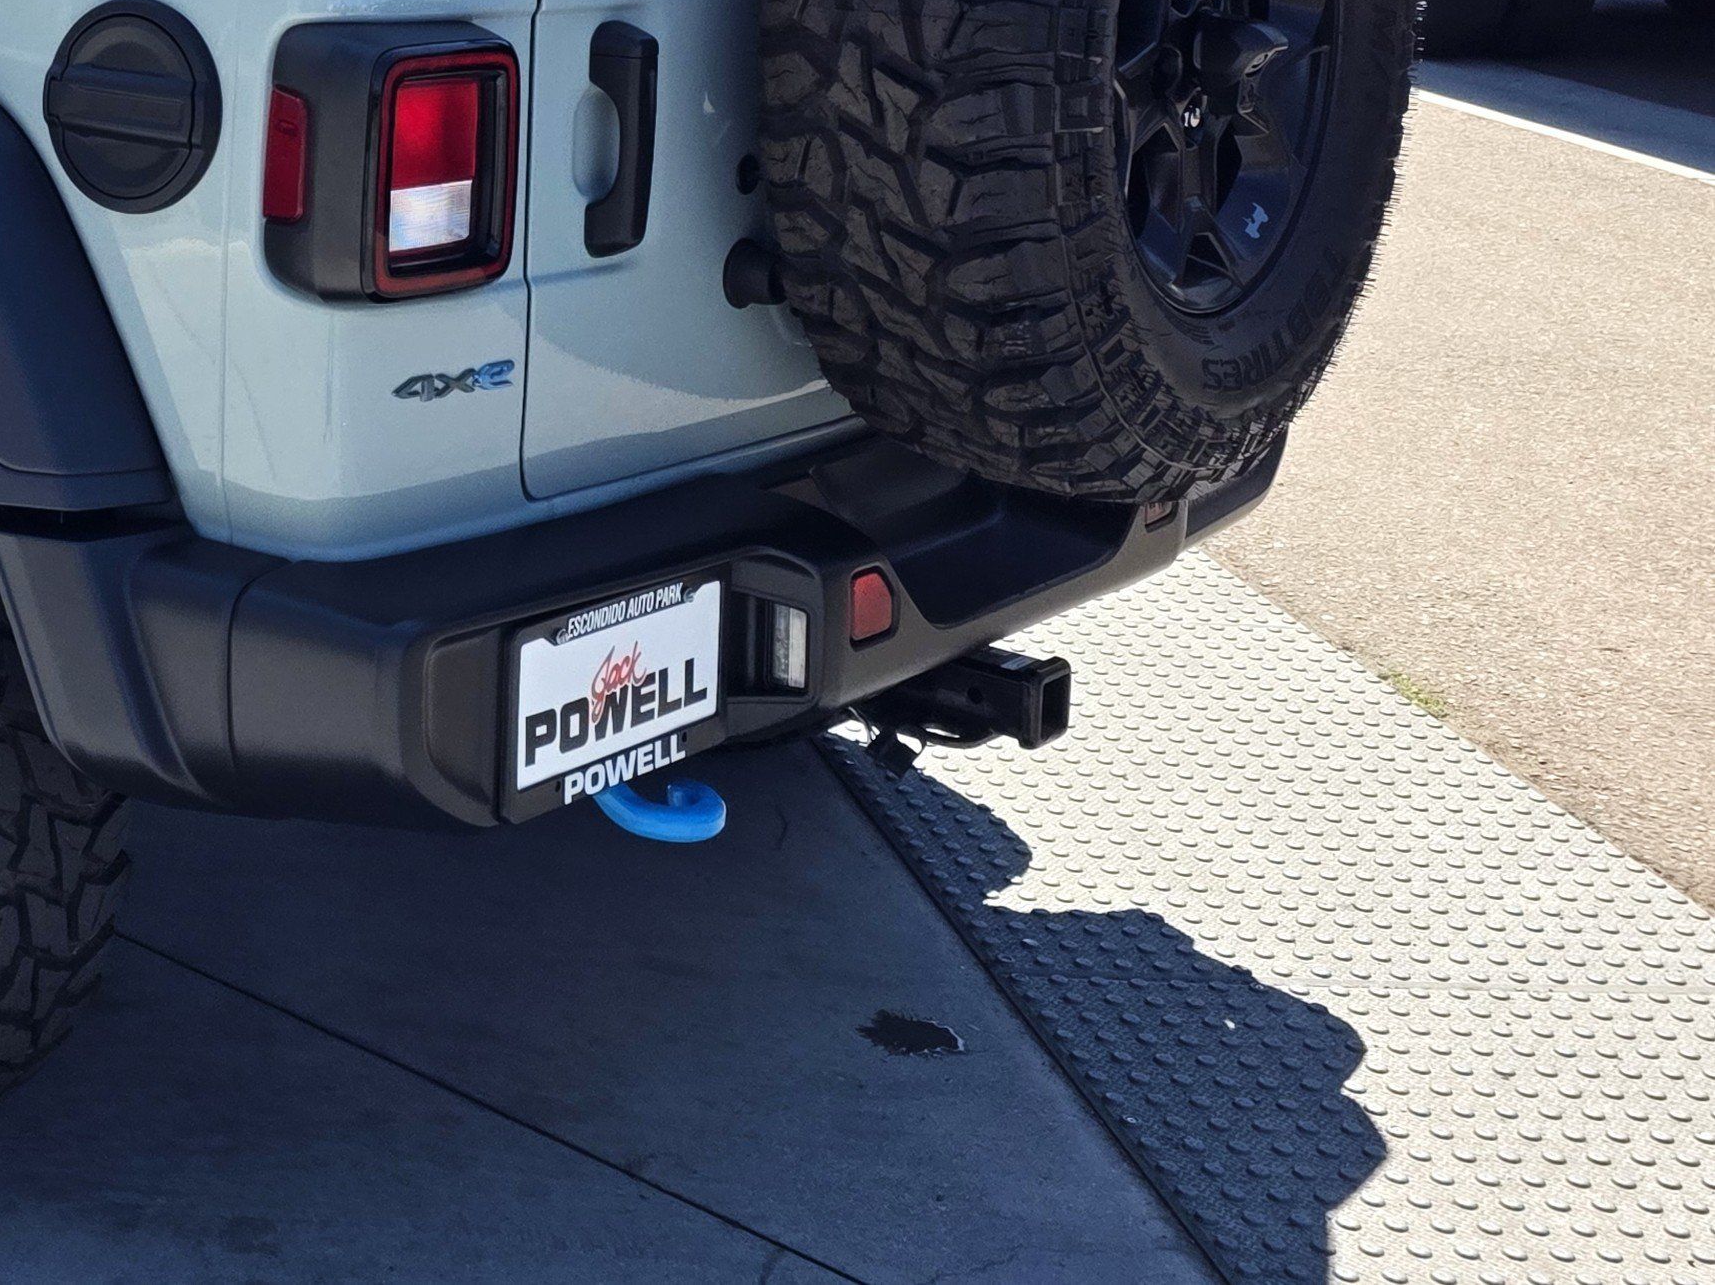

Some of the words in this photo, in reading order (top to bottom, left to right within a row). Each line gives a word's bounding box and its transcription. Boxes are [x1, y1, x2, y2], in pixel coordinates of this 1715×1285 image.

[567, 601, 626, 640] ESCONDIDO
[627, 592, 654, 619] AUTO
[656, 582, 683, 610] PARK
[525, 658, 707, 767] POWELL
[591, 641, 647, 724] Jack
[564, 734, 686, 805] POWELL
